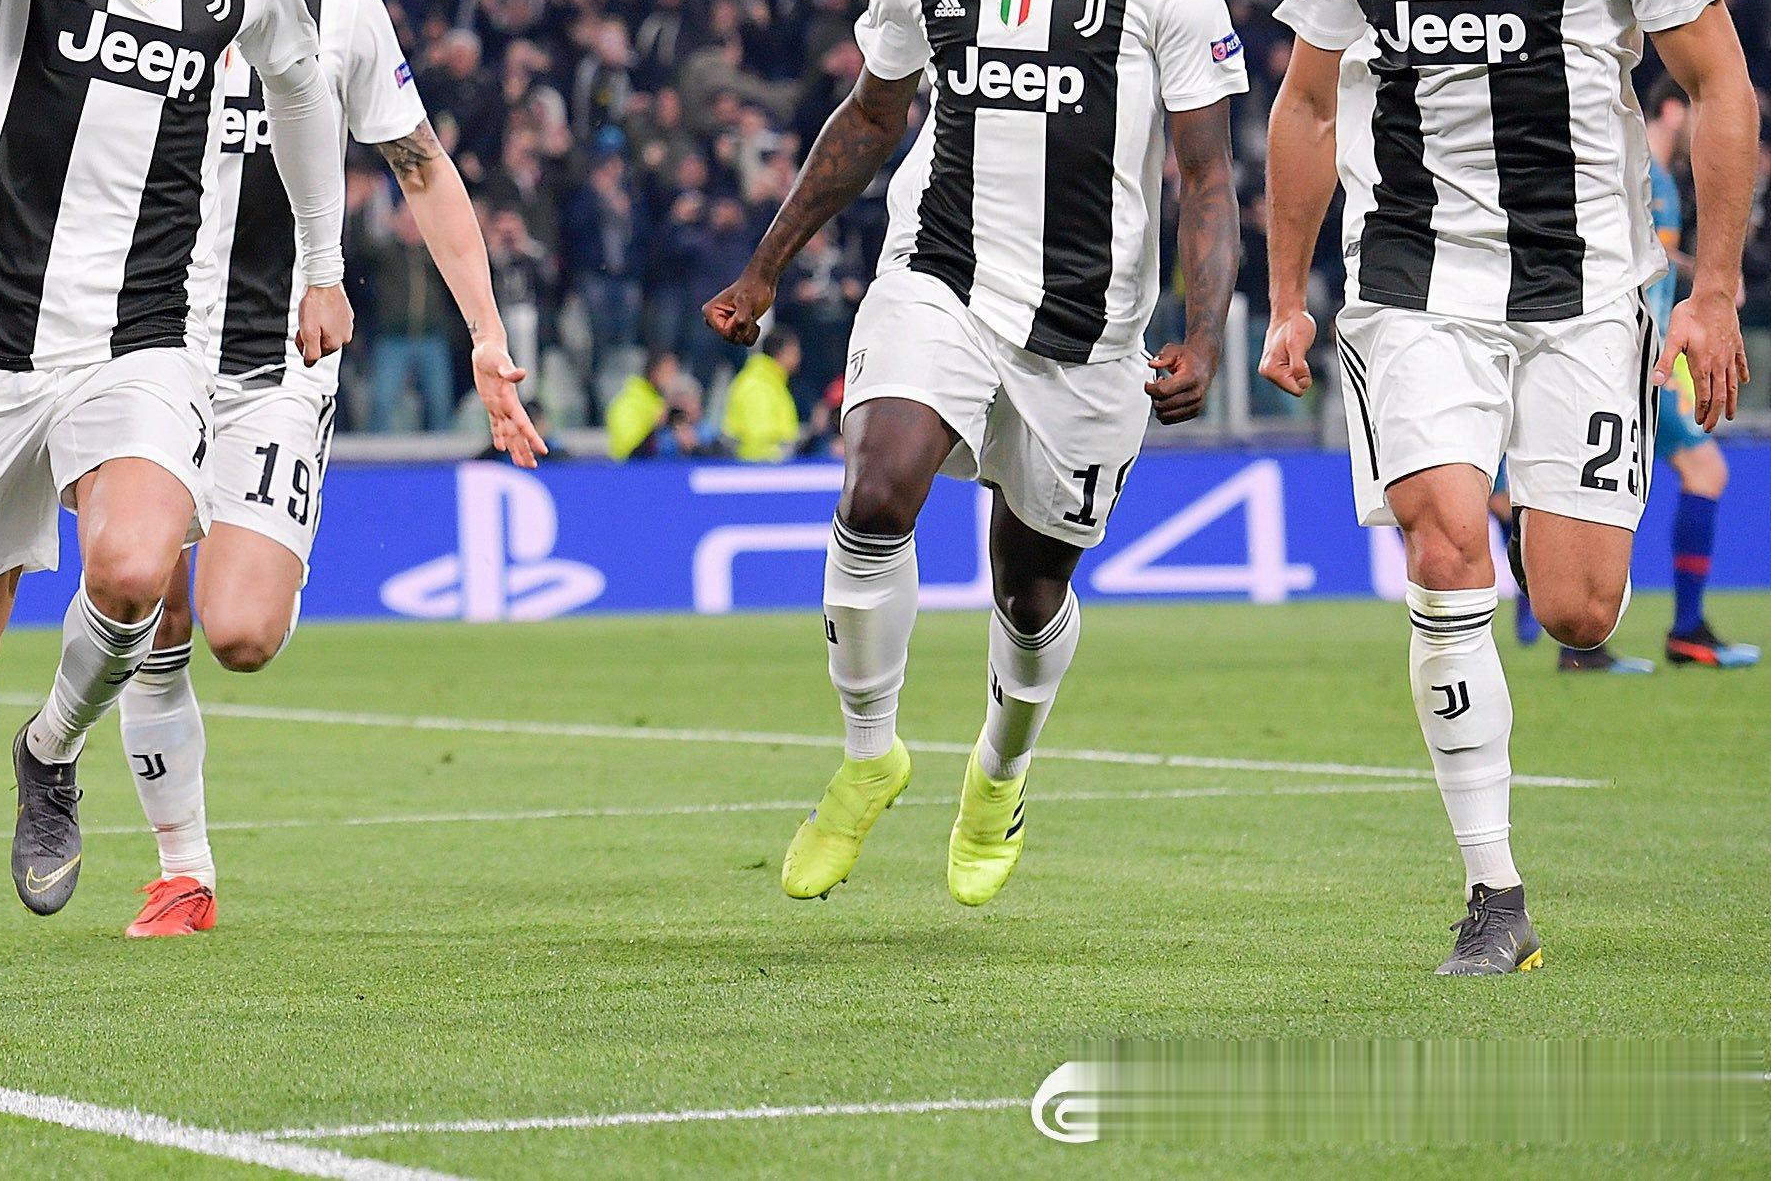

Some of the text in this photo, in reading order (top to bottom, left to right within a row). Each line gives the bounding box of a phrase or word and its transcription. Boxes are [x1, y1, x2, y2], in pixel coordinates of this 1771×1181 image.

[58, 9, 206, 99] Jeep
[1379, 1, 1527, 63] Jeep
[947, 46, 1085, 113] Jeep
[244, 442, 310, 526] 19
